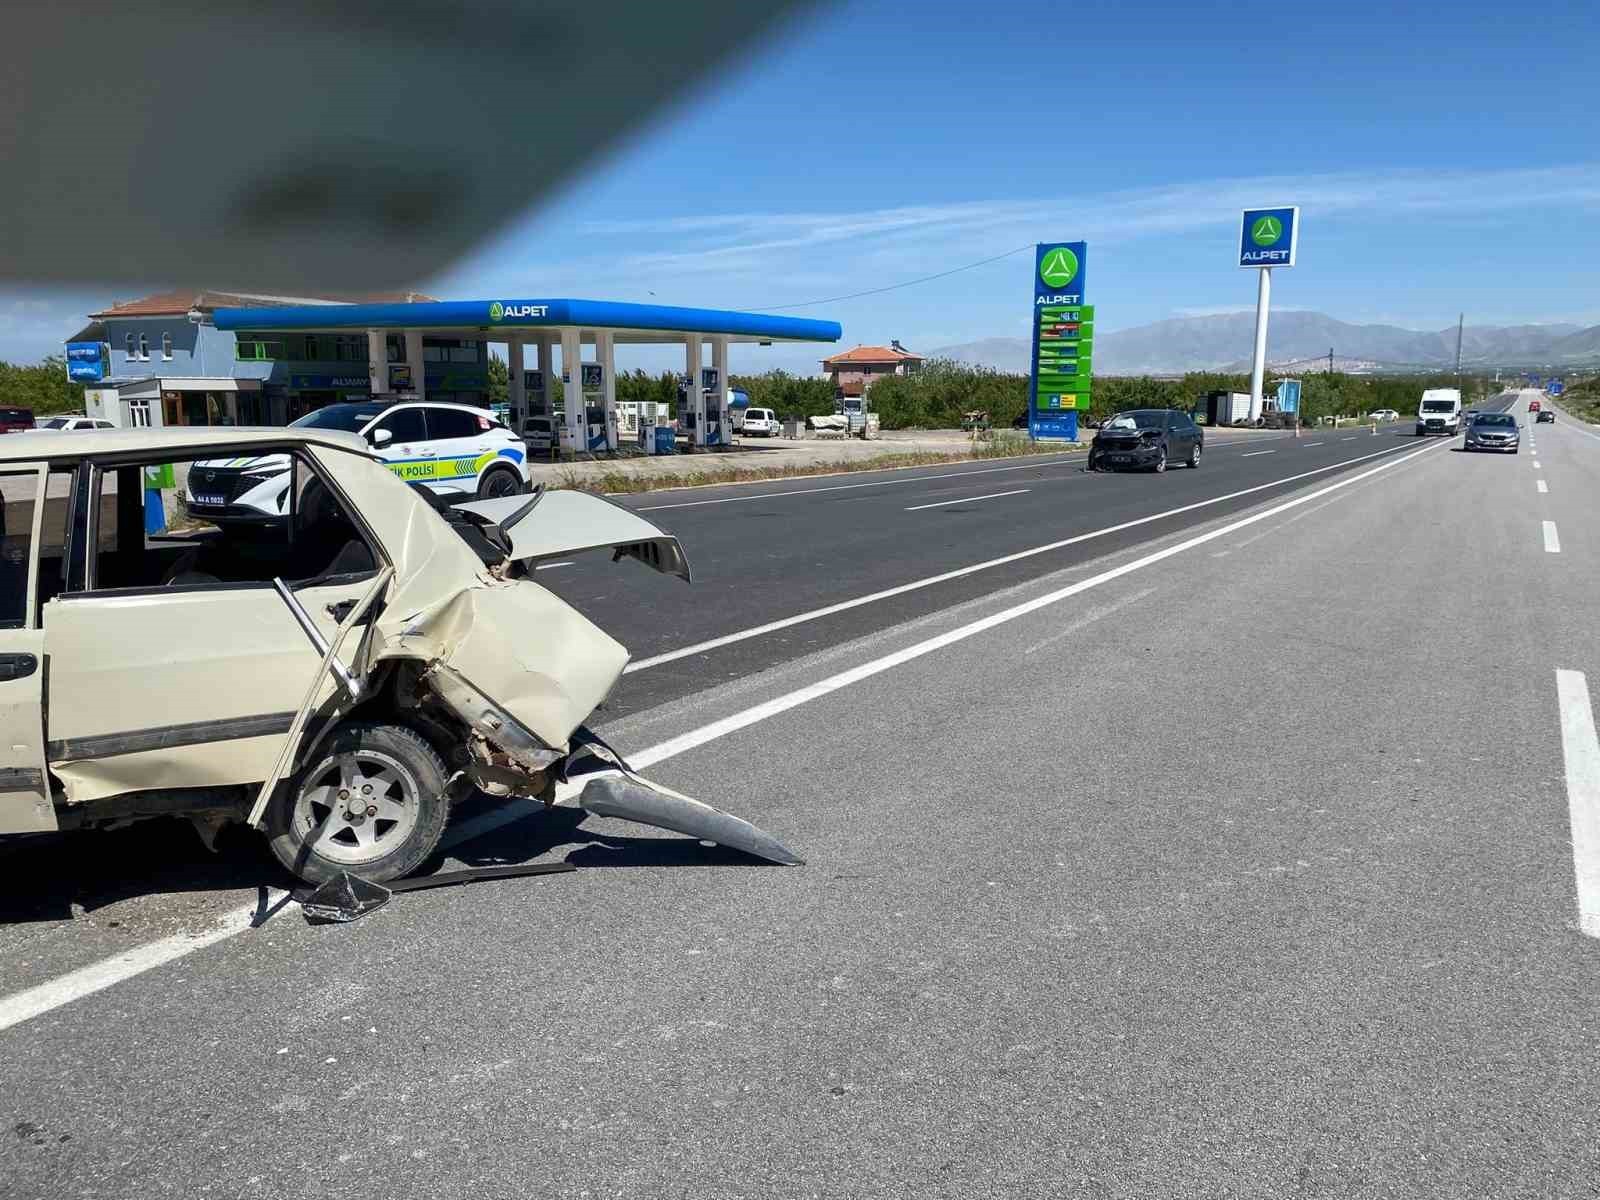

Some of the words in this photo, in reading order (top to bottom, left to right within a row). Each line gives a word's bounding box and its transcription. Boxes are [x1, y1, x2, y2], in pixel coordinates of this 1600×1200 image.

[1241, 250, 1289, 260] ALPET
[1036, 294, 1080, 304] ALPET
[504, 305, 549, 317] ALPET
